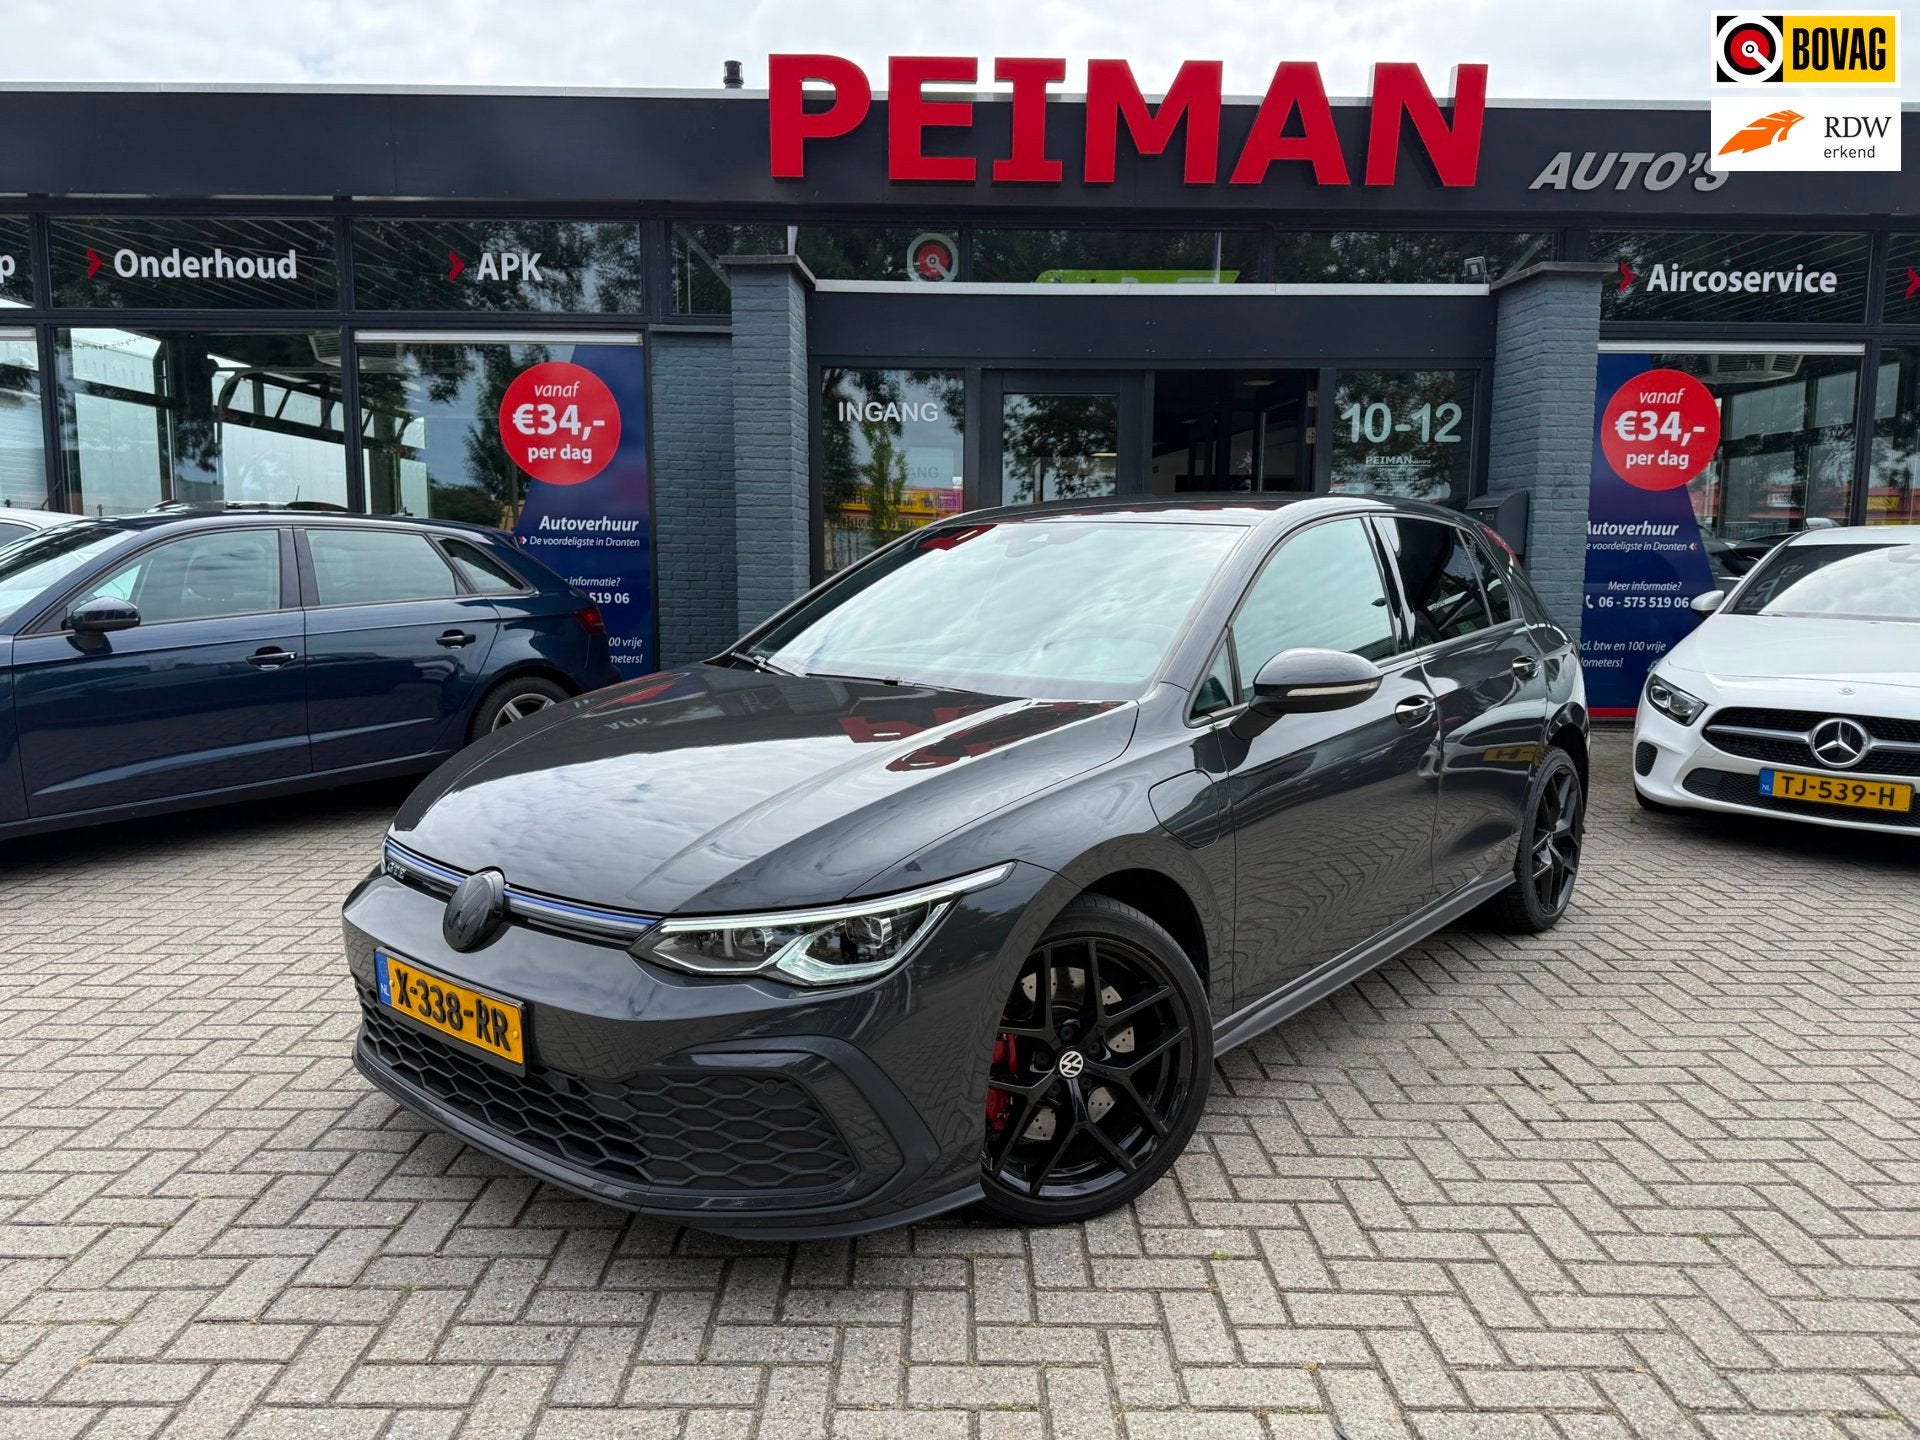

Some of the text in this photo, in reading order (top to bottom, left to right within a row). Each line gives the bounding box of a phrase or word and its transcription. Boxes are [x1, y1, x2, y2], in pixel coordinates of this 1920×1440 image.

[769, 54, 1488, 187] PEIMAN
[1528, 152, 1730, 192] AUTO'S
[113, 248, 297, 279] Onderhoud
[476, 252, 543, 281] APK
[1646, 263, 1838, 293] Aircoservice
[534, 381, 580, 398] vanaf
[1639, 388, 1686, 404] vanaf
[838, 401, 939, 422] INGANG
[512, 403, 605, 440] €34,-
[1340, 402, 1462, 443] 10-12
[1615, 410, 1705, 447] €34,-
[528, 444, 592, 463] per dag
[1365, 455, 1412, 465] PEIMAN
[1626, 450, 1689, 469] per dag
[539, 515, 639, 532] Autoverhuur
[529, 536, 640, 548] De voordeligste in Dronten
[1592, 541, 1642, 552] voordeligste
[1643, 542, 1651, 550] in
[1653, 542, 1687, 551] Dronten
[569, 576, 621, 587] informatie?
[1608, 580, 1682, 591] Meer informatie?
[614, 592, 630, 604] 06
[1598, 596, 1613, 608] 06
[1624, 596, 1647, 608] 575
[1649, 596, 1671, 608] 519
[1674, 597, 1689, 608] 06
[622, 636, 643, 650] vrije
[1594, 640, 1612, 651] btw
[1613, 642, 1625, 651] en
[1628, 641, 1644, 651] 100
[1646, 641, 1666, 654] vrije
[1781, 775, 1895, 806] TJ-539-H
[380, 982, 390, 998] NL
[395, 968, 511, 1052] X-338-RR
